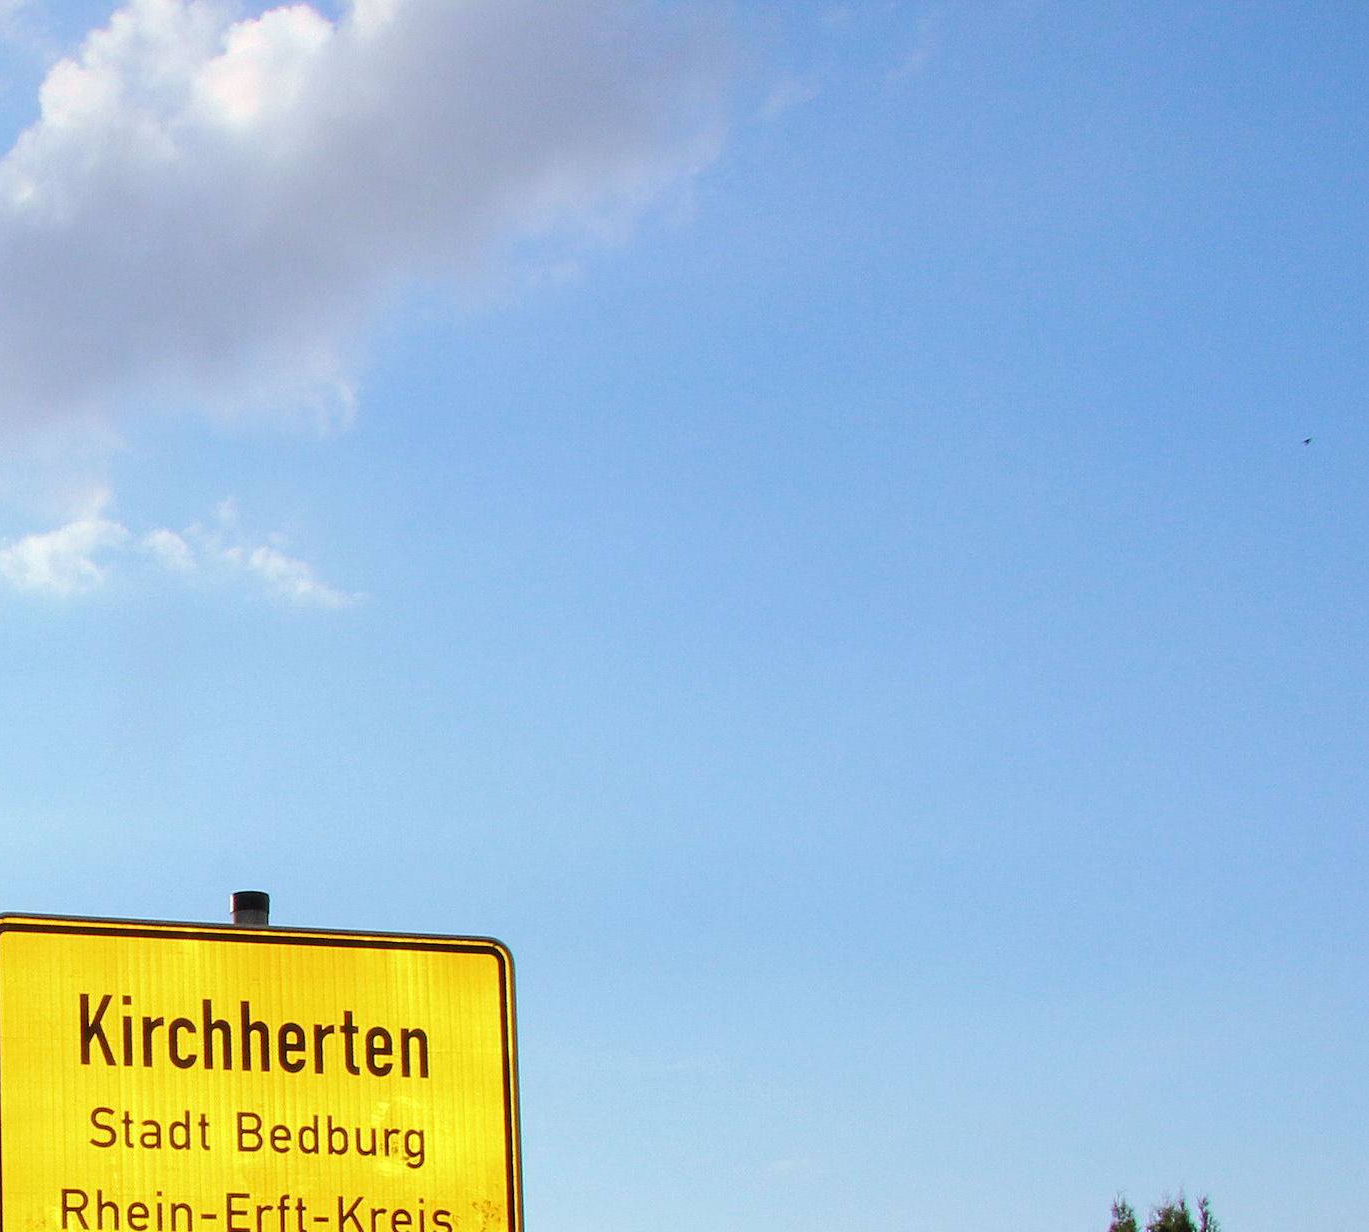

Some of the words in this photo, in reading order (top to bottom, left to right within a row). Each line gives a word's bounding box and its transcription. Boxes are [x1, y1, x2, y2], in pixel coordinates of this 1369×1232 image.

[79, 993, 429, 1079] Kirchherten
[89, 1107, 211, 1151] Stadt
[236, 1112, 426, 1169] Bedburg
[61, 1189, 454, 1232] Rhein-Erft-Kreis
